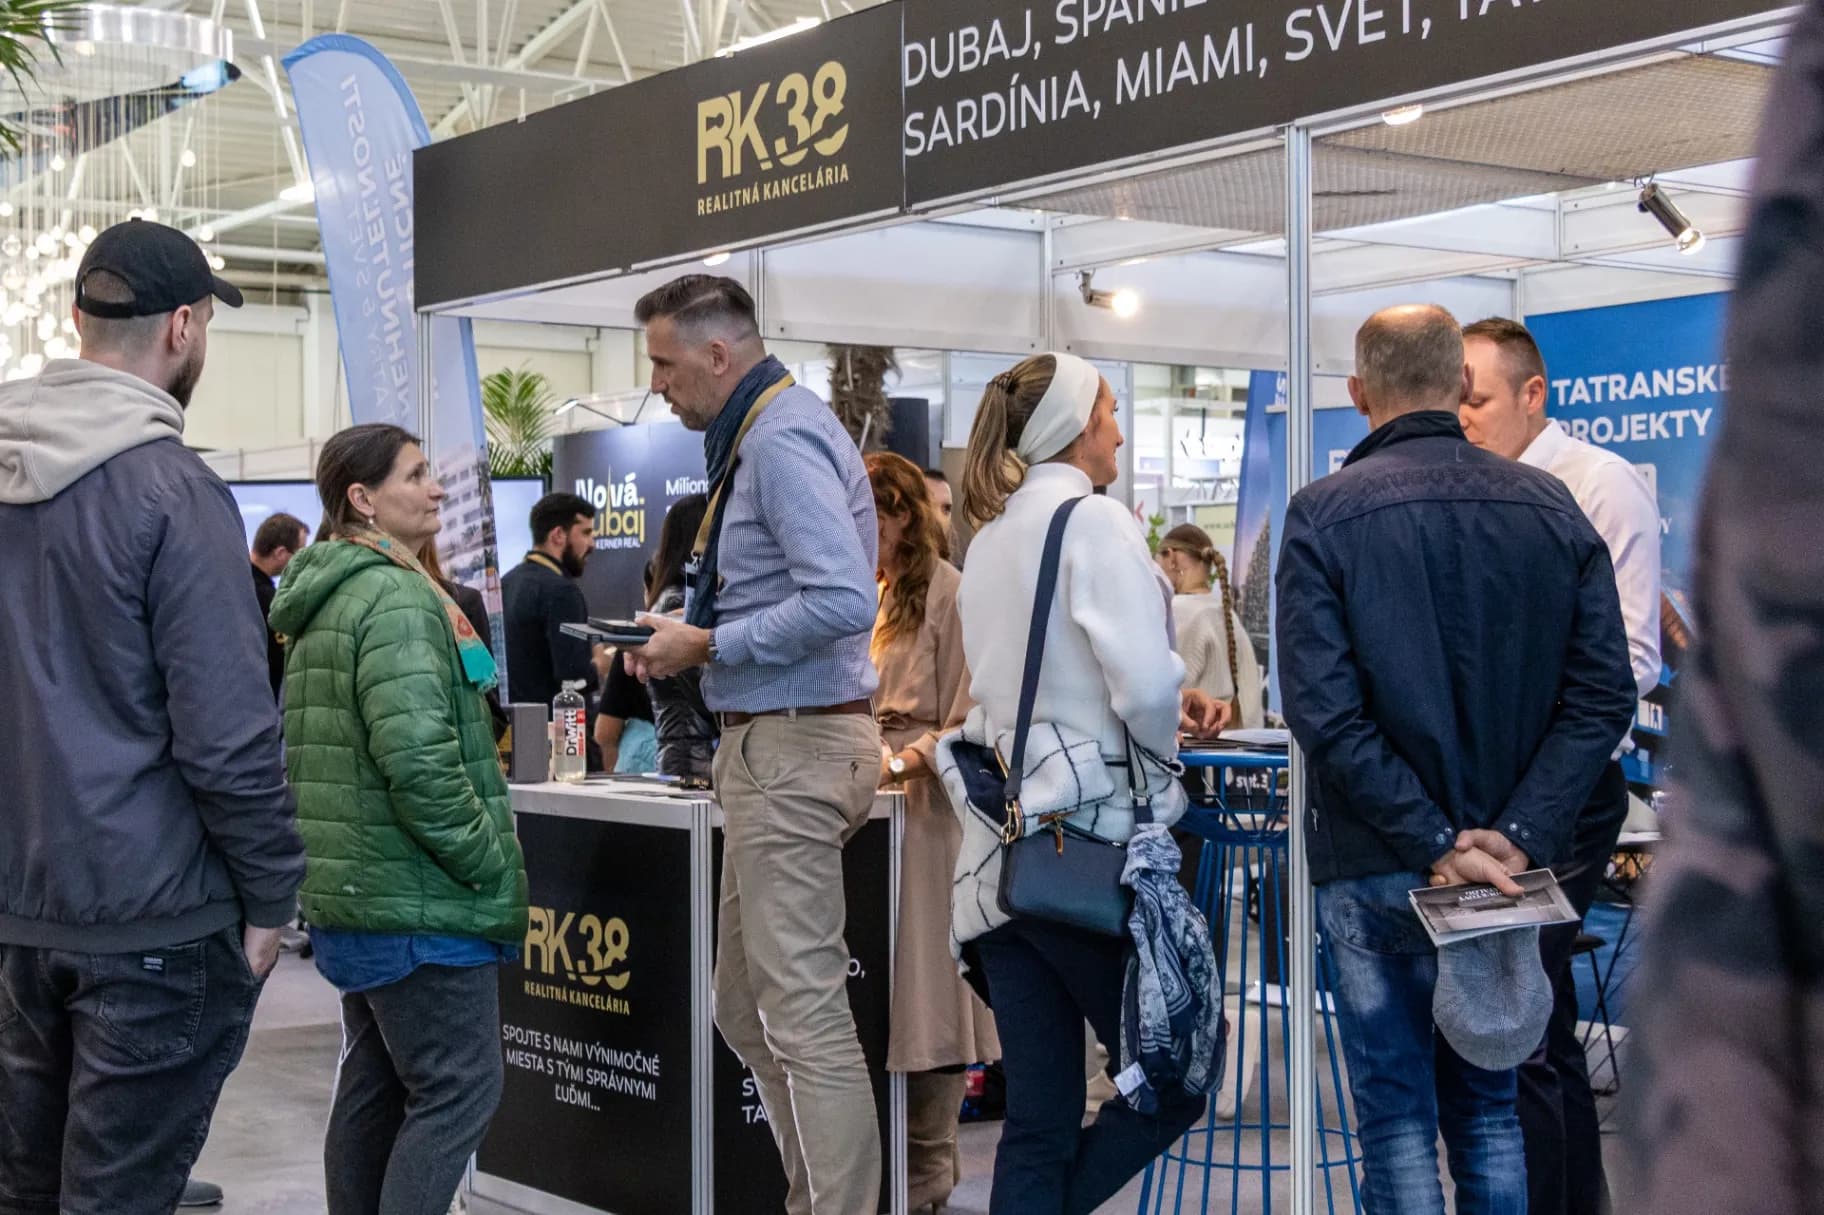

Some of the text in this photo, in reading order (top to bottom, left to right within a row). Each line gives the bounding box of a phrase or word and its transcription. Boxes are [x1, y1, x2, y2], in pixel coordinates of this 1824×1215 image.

[904, 9, 1041, 87] DUBAJ,
[904, 70, 1101, 156] SARDÍNIA,
[1115, 24, 1268, 105] MIAMI,
[697, 163, 849, 217] REALITNÁ KANCELÁRIA
[592, 497, 645, 543] ubaj
[524, 980, 631, 1016] REALITNÁ KANCELÁRIA
[502, 1024, 660, 1077] SPOJTE S NAMI VÝNIMOČNÉ
[506, 1048, 656, 1101] MIESTA S TÝMI SPRÁVNYMI
